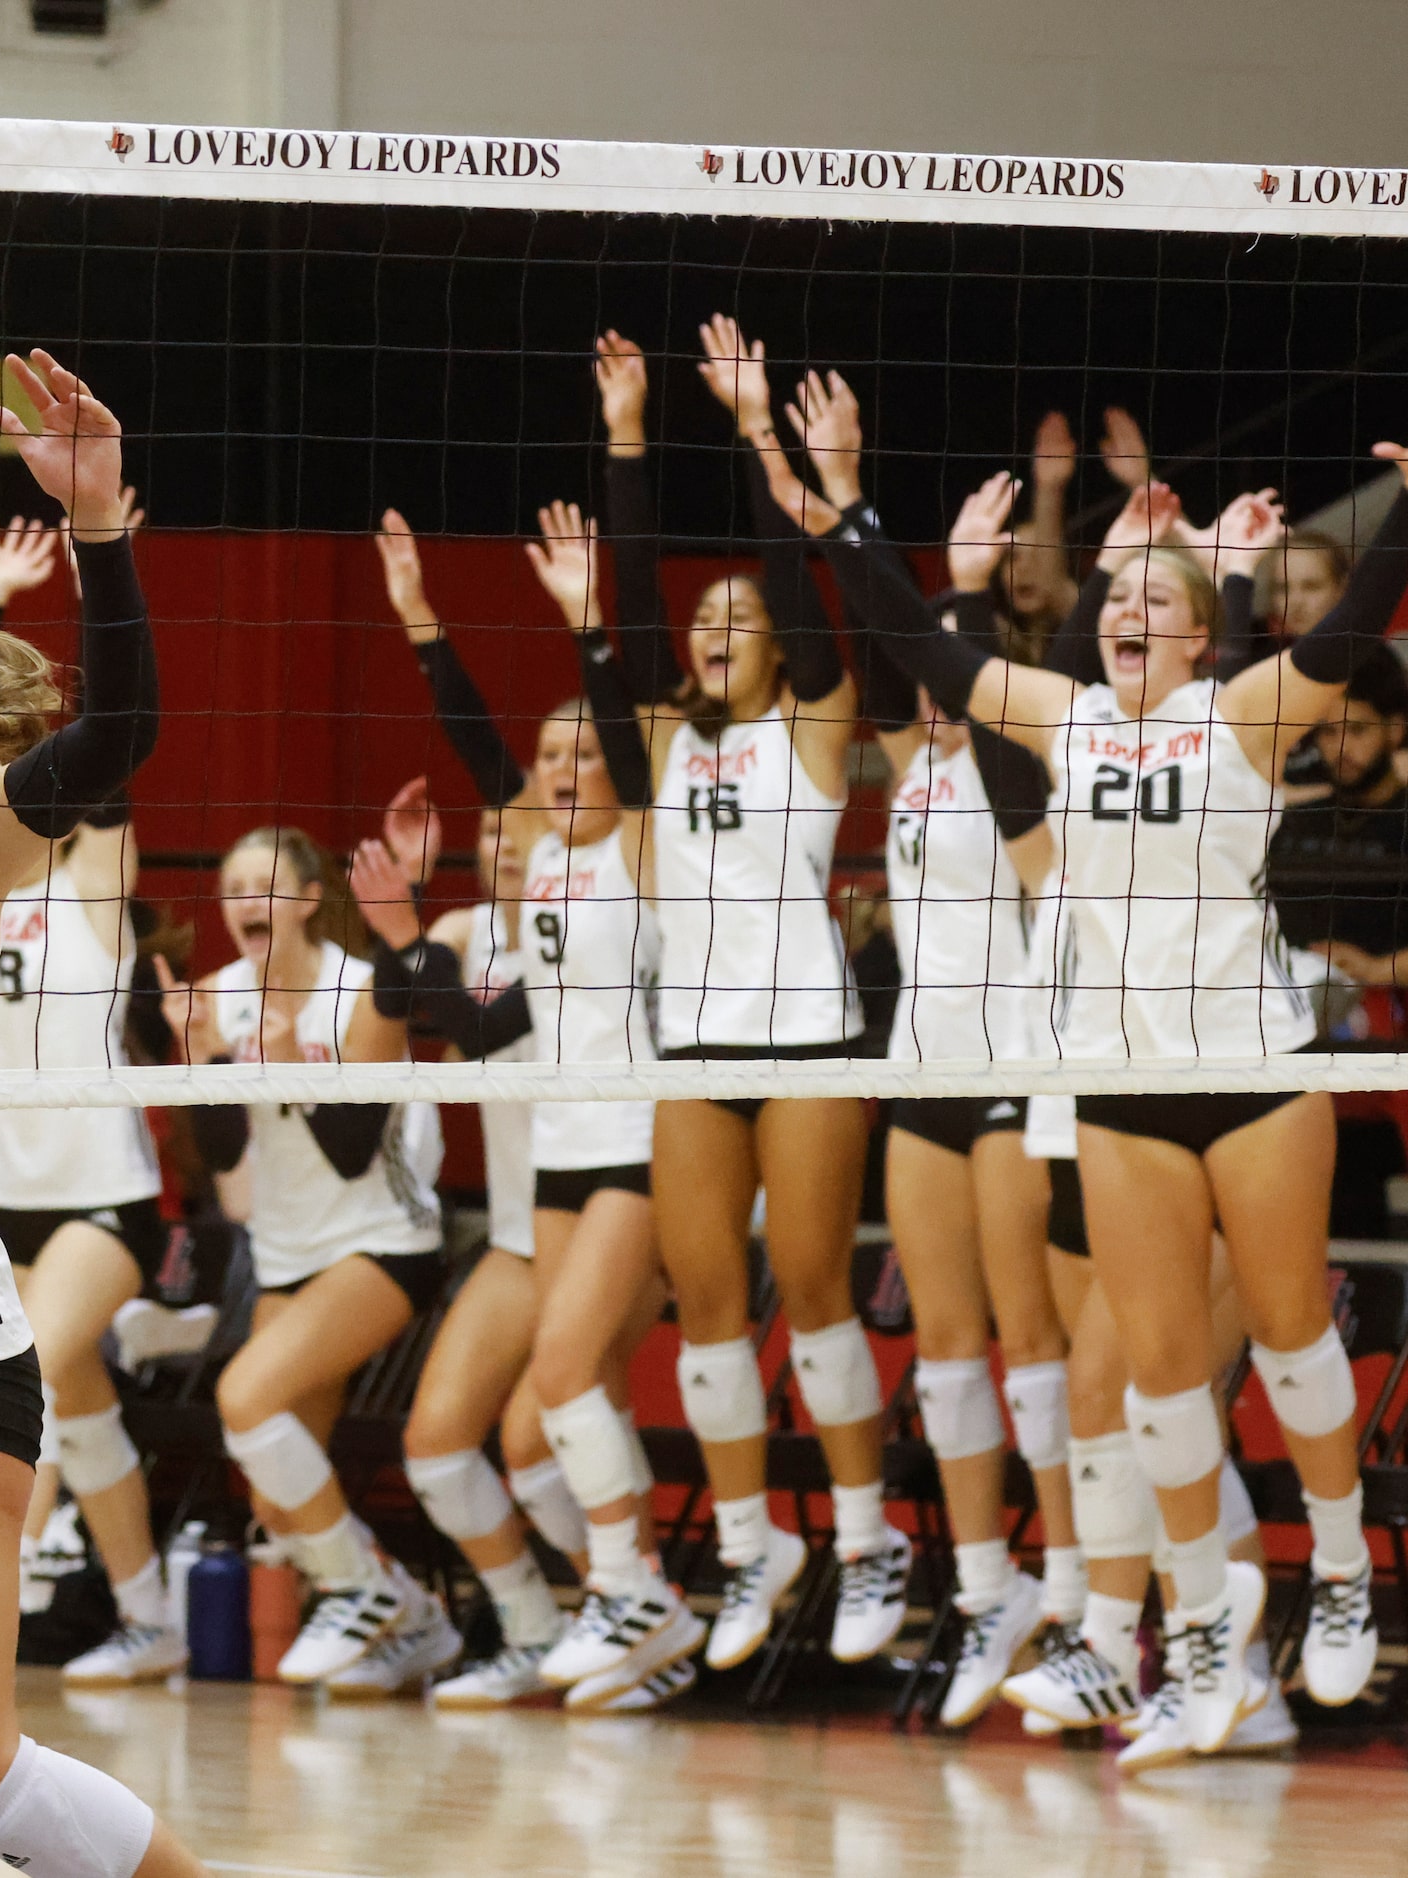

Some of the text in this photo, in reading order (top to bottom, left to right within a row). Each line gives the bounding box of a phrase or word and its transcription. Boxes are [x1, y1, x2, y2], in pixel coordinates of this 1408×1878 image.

[145, 128, 338, 170] LOVEJOY
[348, 135, 561, 179] LEOPARDS
[733, 150, 921, 191] LOVEJOY
[923, 157, 1125, 199] LEOPARDS
[1289, 168, 1408, 206] LOVEJ
[689, 784, 741, 832] 16
[1092, 763, 1180, 824] 20
[534, 911, 564, 964] 9
